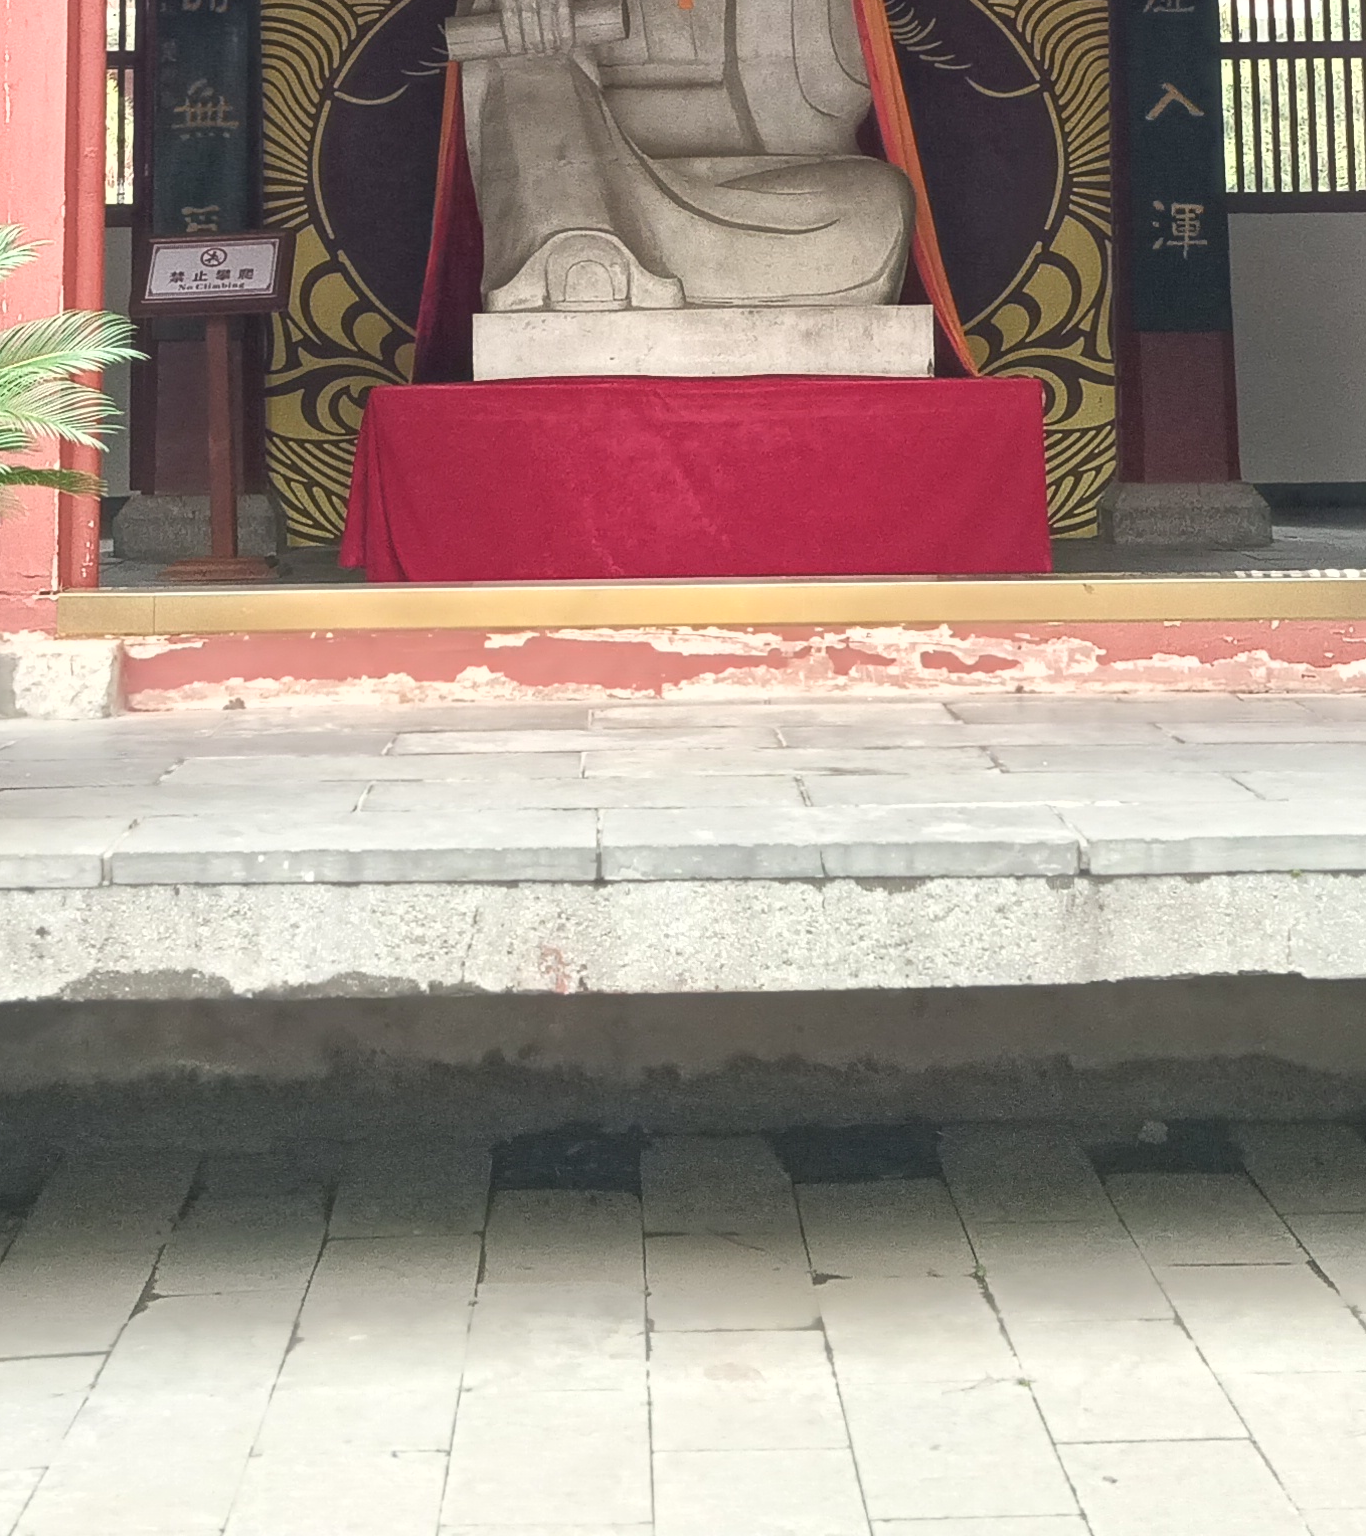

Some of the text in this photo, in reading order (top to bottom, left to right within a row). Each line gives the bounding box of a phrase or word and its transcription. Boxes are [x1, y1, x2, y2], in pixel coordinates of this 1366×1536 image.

[168, 268, 255, 284] 禁止攀爬
[178, 282, 246, 291] No Climbing
